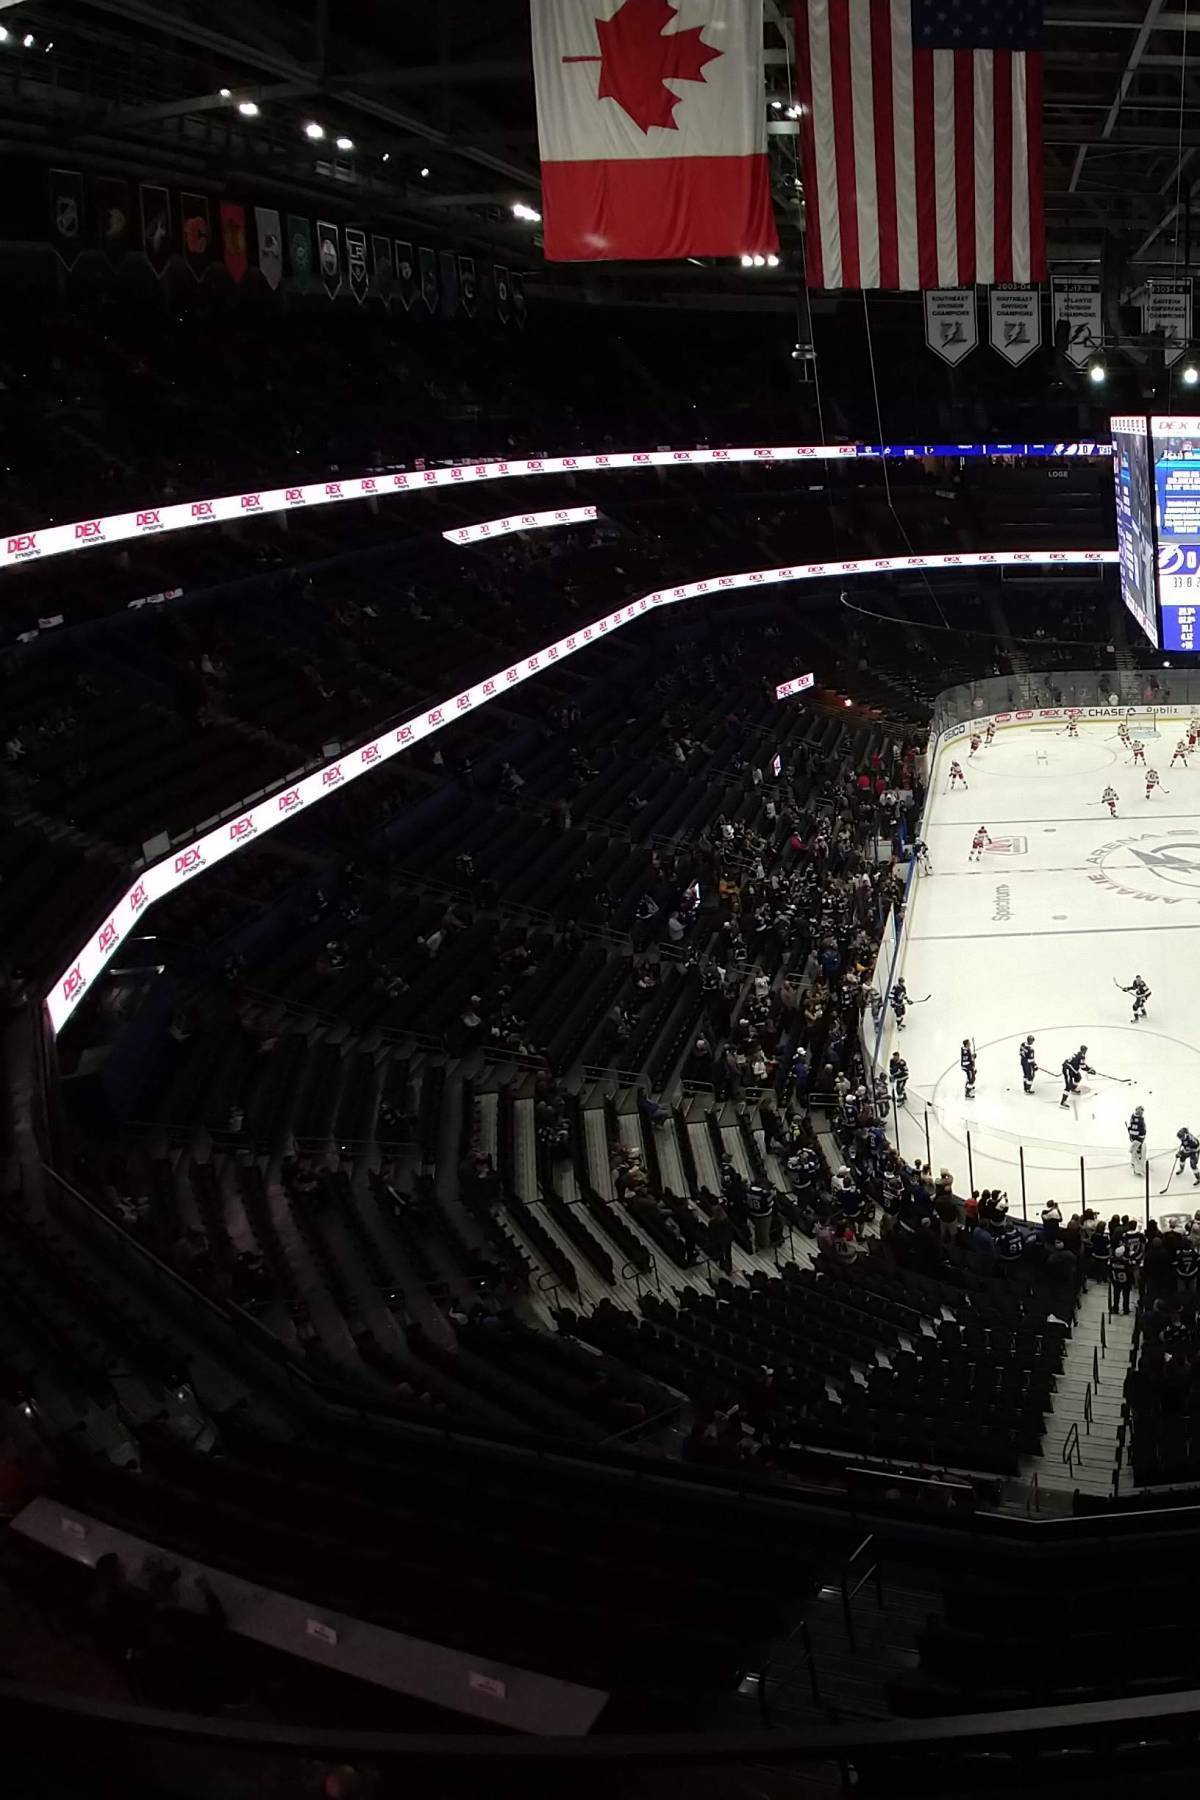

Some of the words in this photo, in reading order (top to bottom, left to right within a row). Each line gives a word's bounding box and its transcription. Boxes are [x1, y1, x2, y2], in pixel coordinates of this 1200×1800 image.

[361, 480, 376, 489] DEX
[394, 475, 407, 485] DEX
[424, 472, 436, 481] DEX
[285, 489, 303, 501] DEX
[325, 484, 341, 494] DEX
[192, 503, 213, 516] DEX
[241, 496, 260, 508] DEX
[136, 511, 160, 526] DEX
[75, 522, 101, 539] DEX
[7, 535, 36, 554] DEX
[1187, 551, 1197, 568] 0
[1088, 708, 1125, 717] CHASE
[944, 724, 966, 742] GEICO
[322, 764, 341, 785] DEX
[279, 788, 300, 811] DEX
[230, 815, 253, 840] DEX
[1086, 832, 1163, 865] ARENA
[175, 845, 201, 873] DEX
[130, 881, 145, 911] DEX
[99, 918, 116, 952] DEX
[63, 963, 82, 1000] DEX
